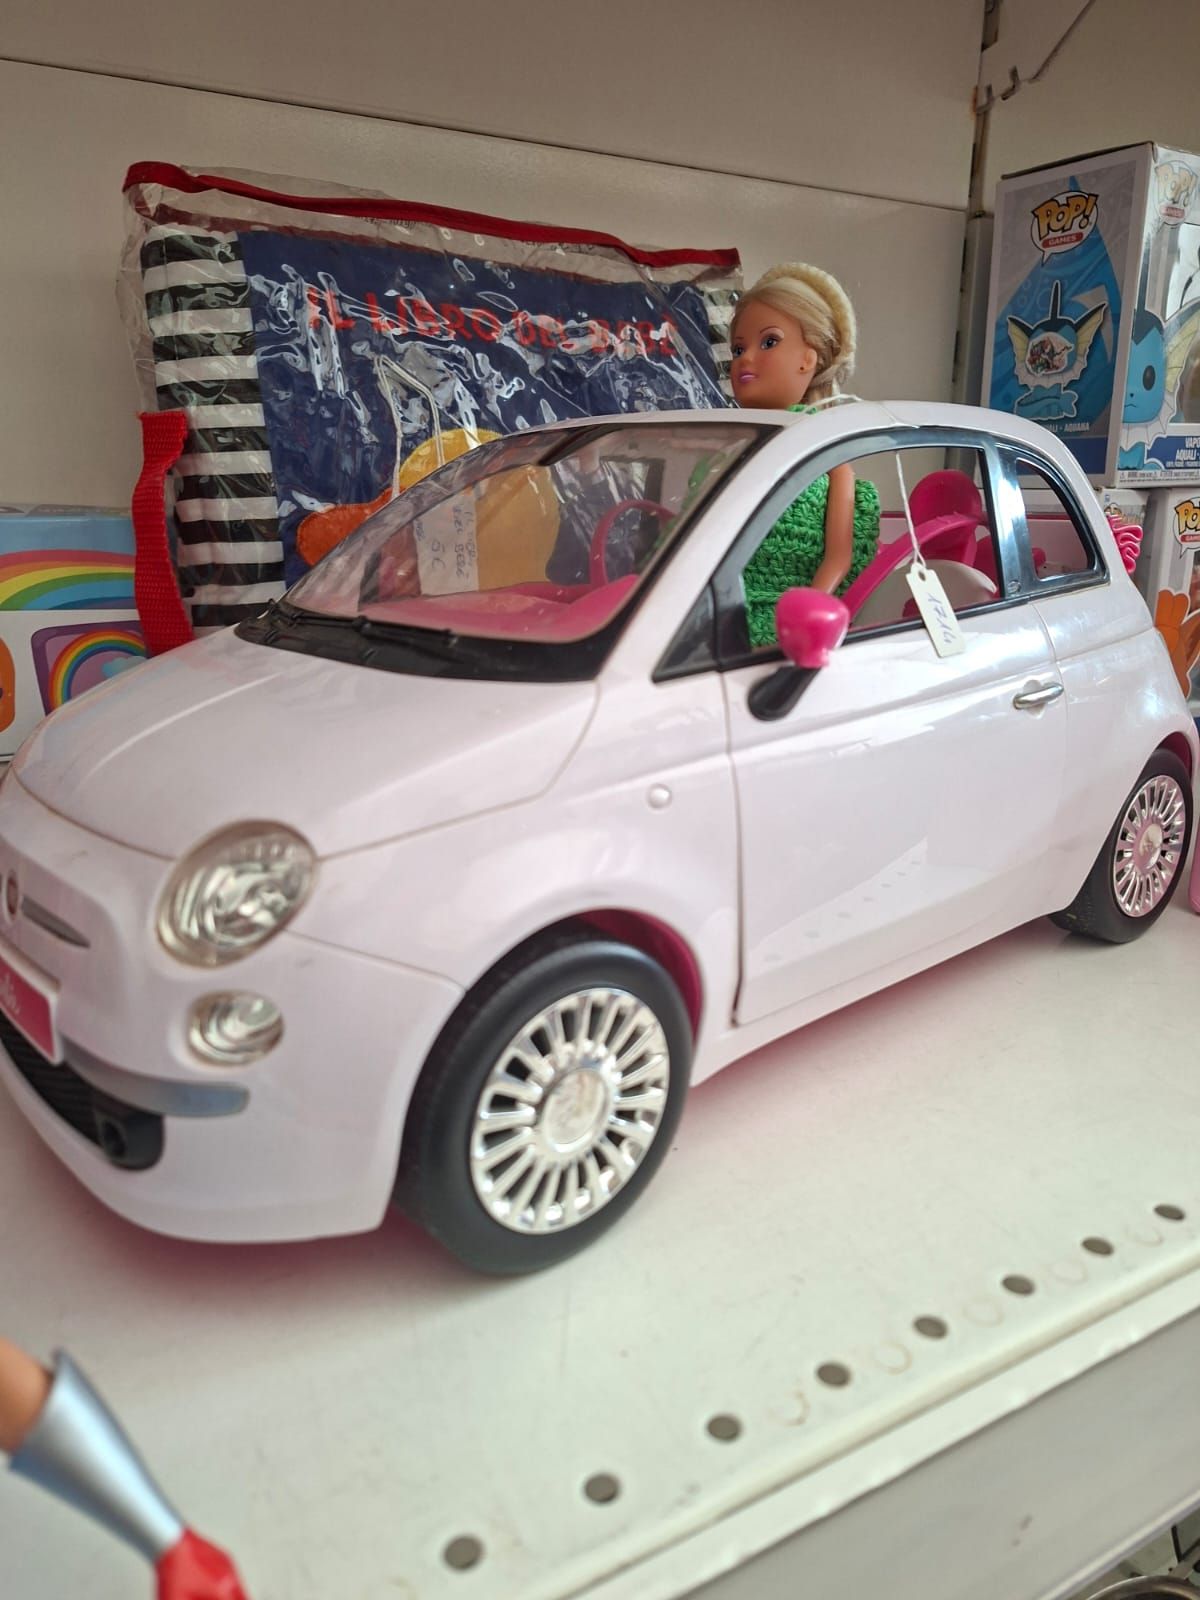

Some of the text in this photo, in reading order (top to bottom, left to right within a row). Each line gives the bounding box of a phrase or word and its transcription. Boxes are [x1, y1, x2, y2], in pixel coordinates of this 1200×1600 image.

[1031, 193, 1099, 240] POP!
[1048, 234, 1078, 246] GAMES
[307, 287, 356, 332] IL
[365, 292, 506, 342] LIBRO
